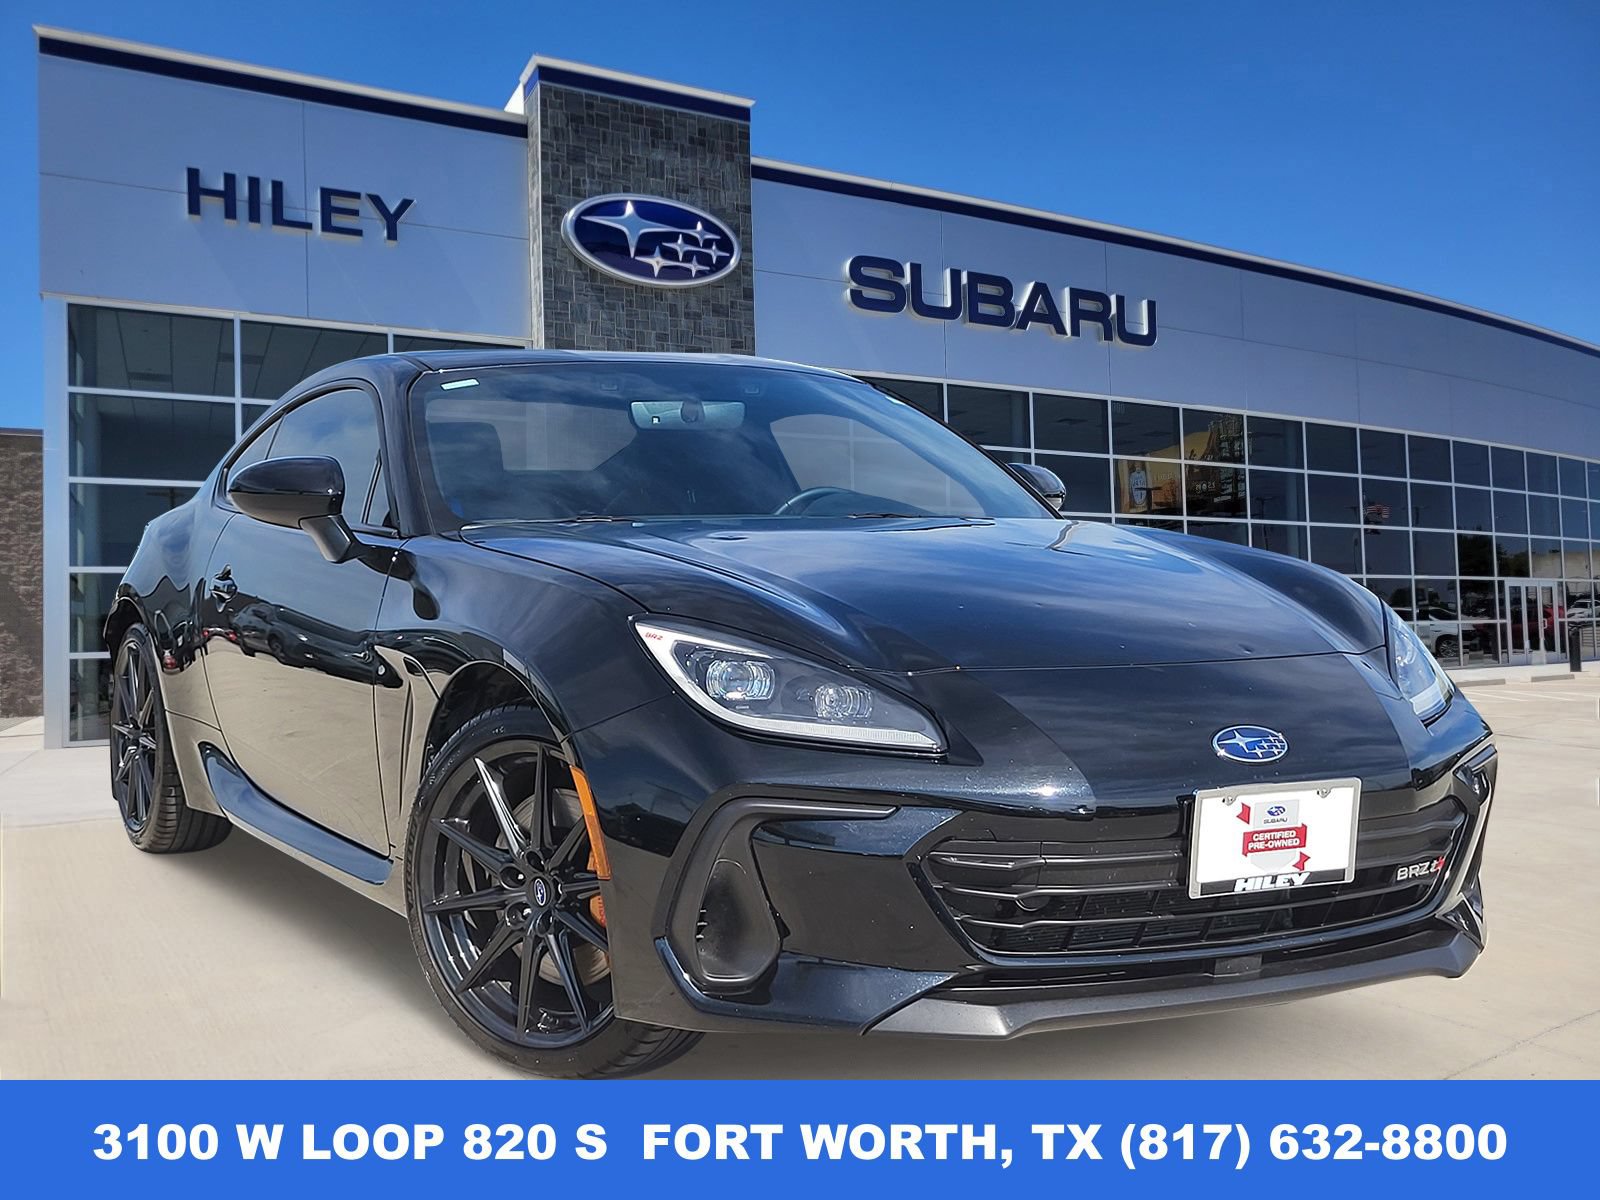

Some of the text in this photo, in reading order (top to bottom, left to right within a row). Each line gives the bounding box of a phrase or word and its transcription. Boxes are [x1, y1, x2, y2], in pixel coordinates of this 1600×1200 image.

[186, 167, 416, 241] HILEY
[848, 255, 1157, 347] SUBARU
[1248, 838, 1300, 851] PRE-OWNED
[1252, 830, 1297, 841] CERTIFIED
[1396, 861, 1430, 881] BRZ
[1233, 872, 1311, 892] HILEY
